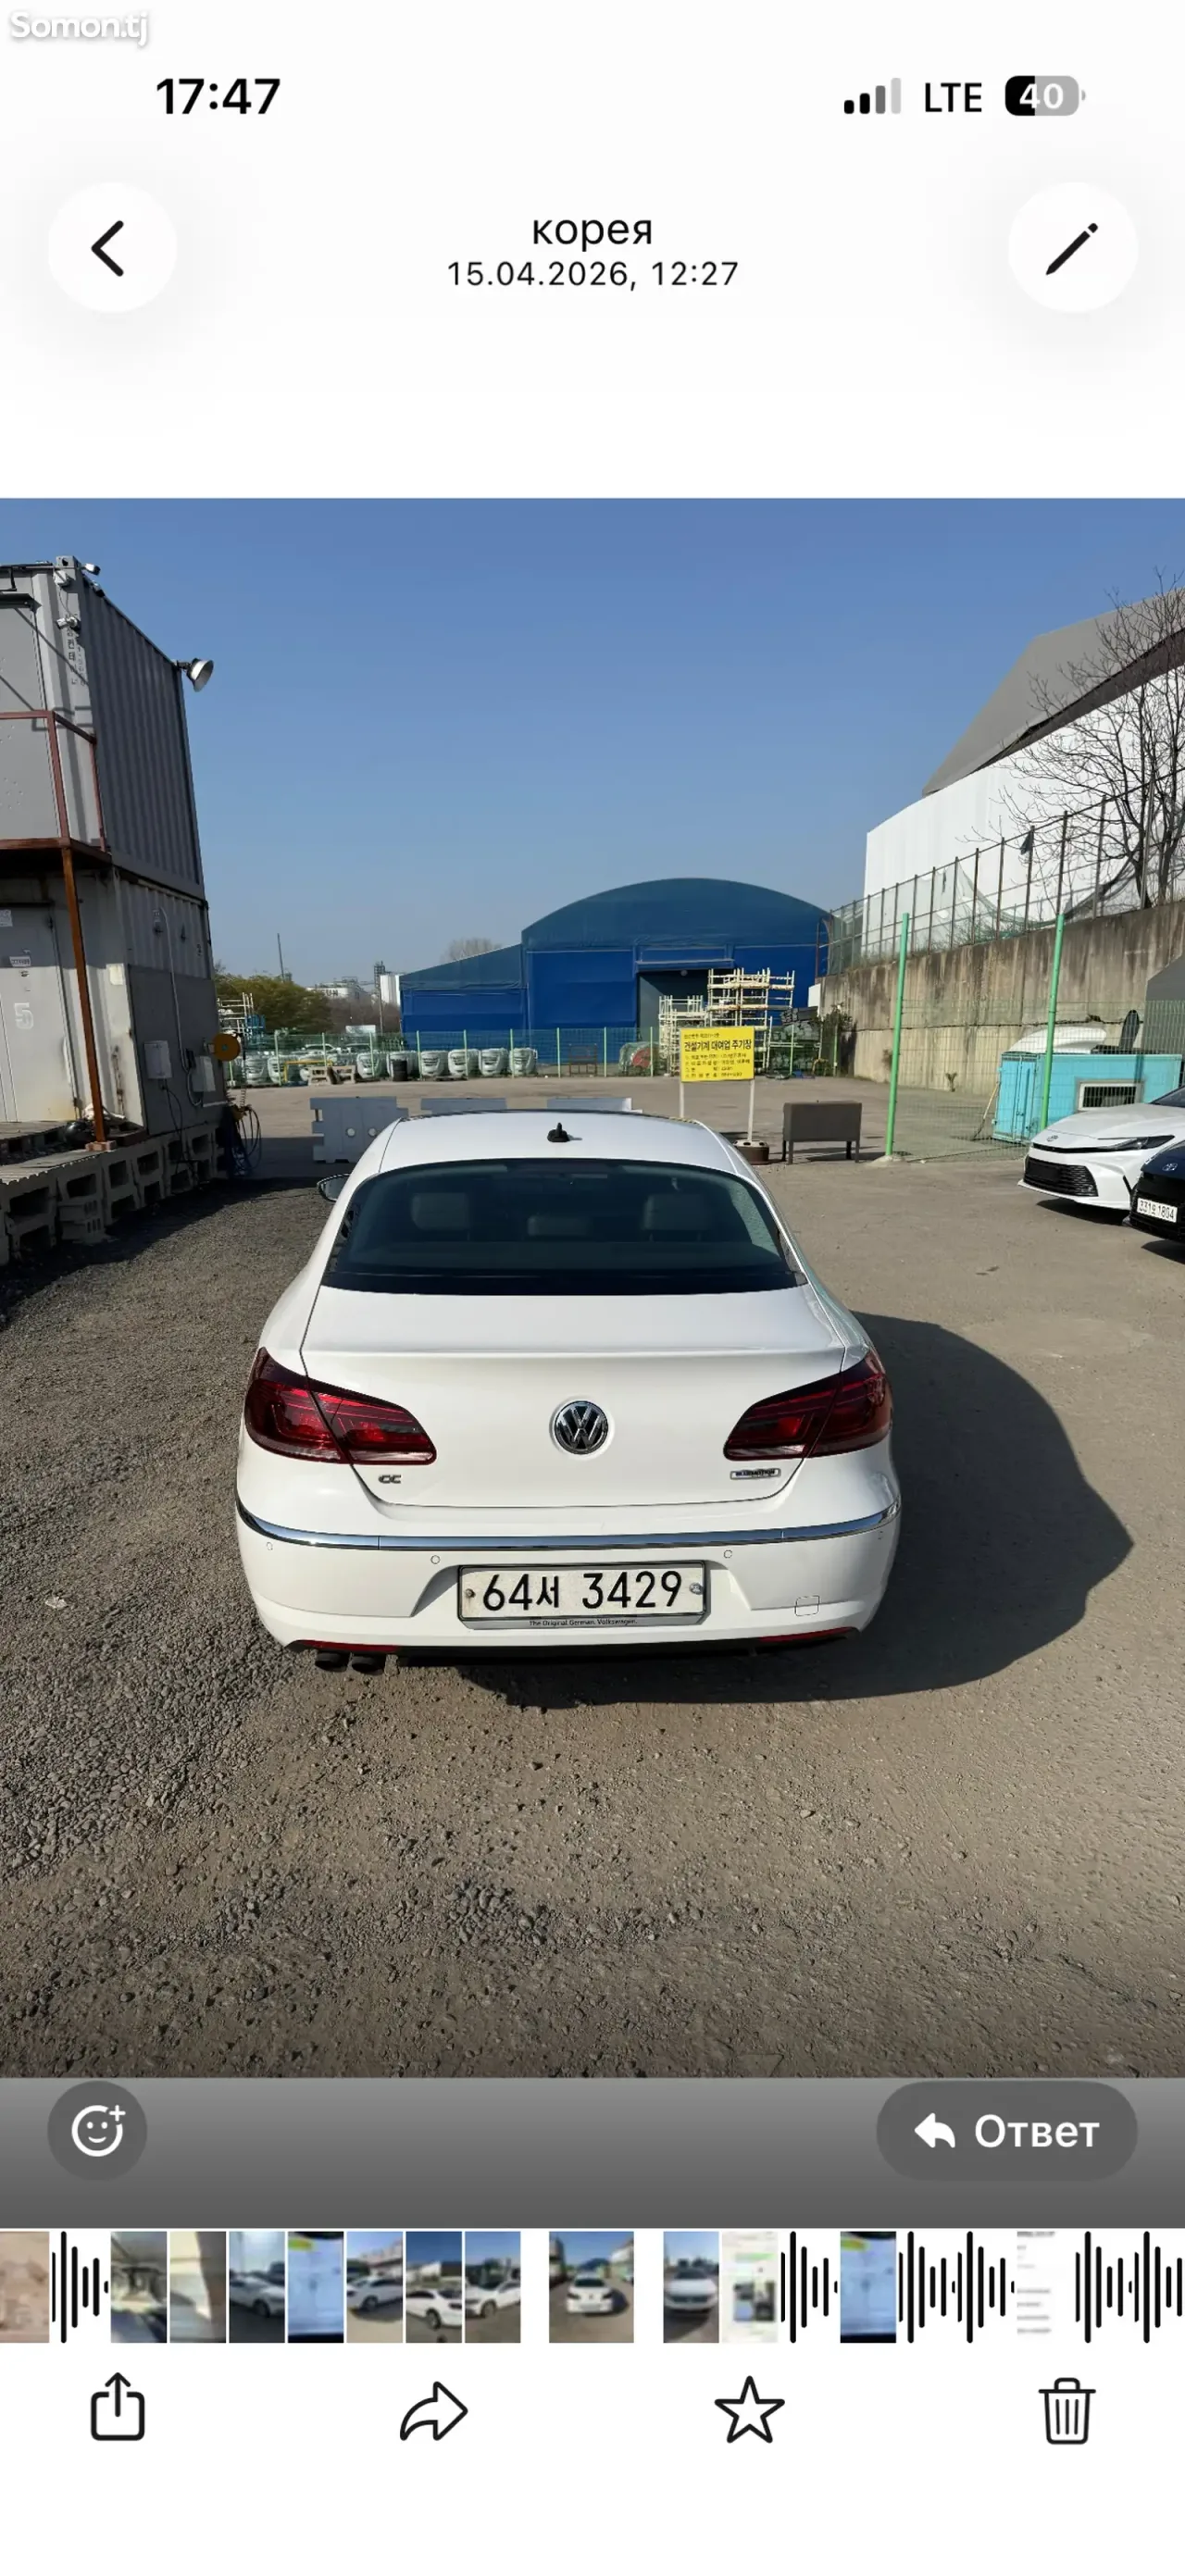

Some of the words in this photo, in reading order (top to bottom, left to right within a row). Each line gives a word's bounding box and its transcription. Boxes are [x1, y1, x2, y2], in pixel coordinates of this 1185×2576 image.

[684, 1040, 710, 1052] 건설기계
[711, 1039, 730, 1051] 대여업
[731, 1039, 752, 1050] 주기장
[378, 1474, 402, 1484] CC
[482, 1574, 559, 1612] 64서
[582, 1570, 682, 1610] 3429
